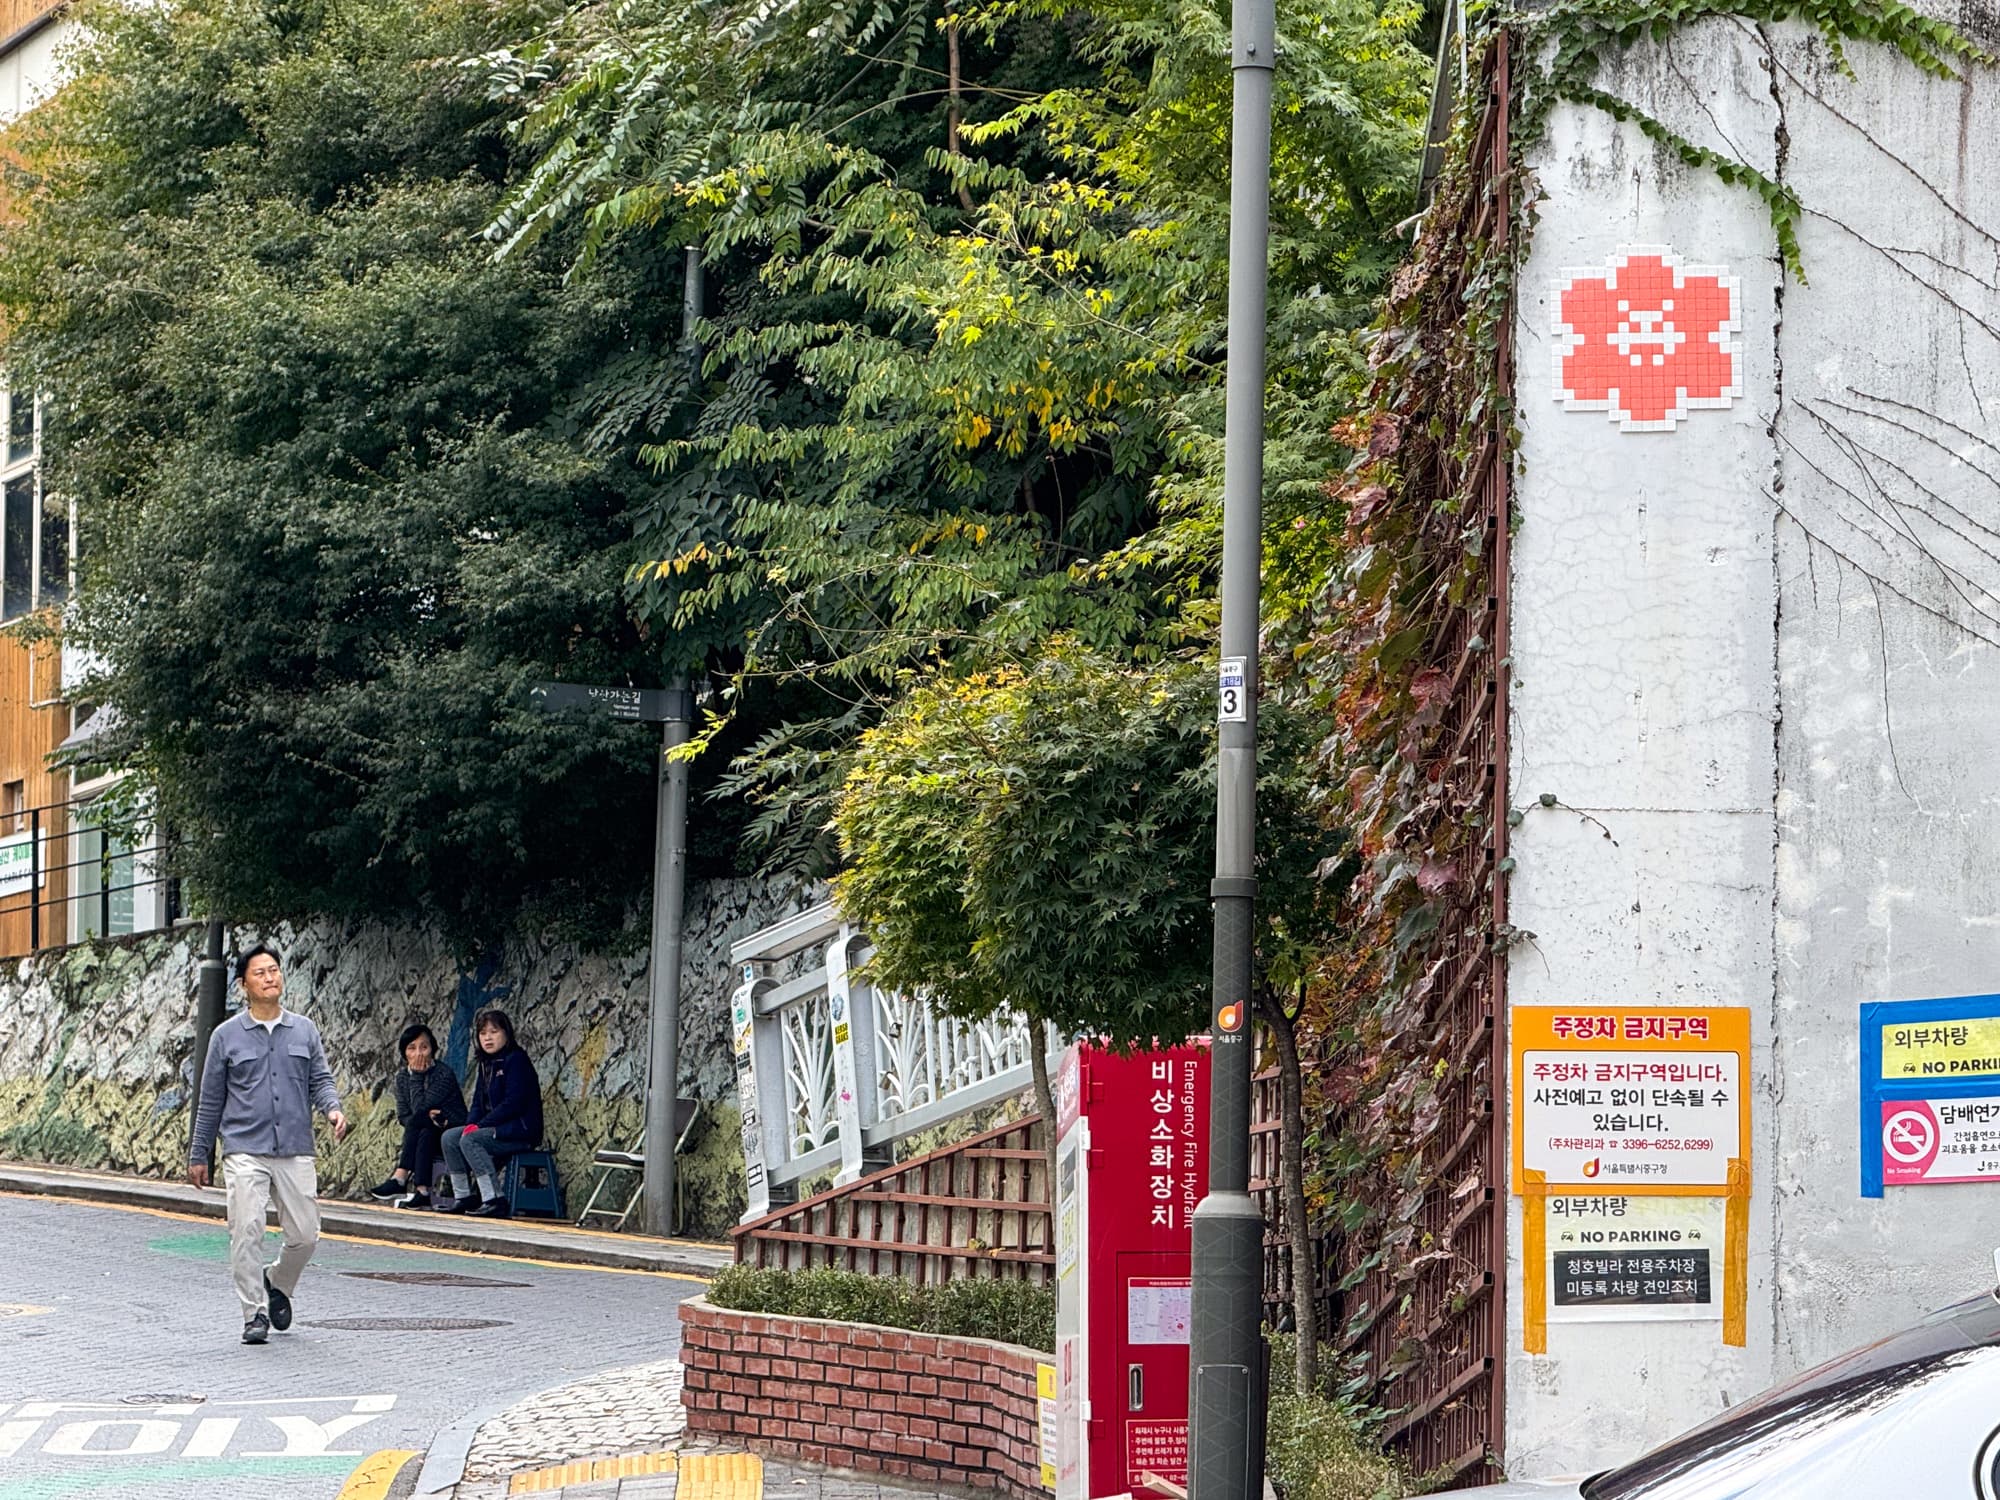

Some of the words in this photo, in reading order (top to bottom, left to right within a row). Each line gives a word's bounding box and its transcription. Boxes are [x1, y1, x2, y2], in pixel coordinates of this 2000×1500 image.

[1224, 689, 1237, 714] 3
[1553, 1016, 1617, 1039] 주정차
[1624, 1016, 1709, 1040] 금지구역
[1894, 1026, 1969, 1049] 외부차량
[1533, 1064, 1588, 1083] 주정차
[1594, 1064, 1728, 1083] 금지구역입니다.
[1922, 1061, 1946, 1074] NO
[1950, 1057, 2000, 1073] PARKI
[1180, 1060, 1198, 1138] Emergency
[1533, 1088, 1604, 1106] 사전예고
[1611, 1088, 1645, 1107] 없이
[1652, 1088, 1705, 1107] 단속될
[1711, 1088, 1729, 1107] 수
[1593, 1114, 1669, 1132] 있습니다.
[1149, 1059, 1175, 1229] 비상소화장치
[1548, 1137, 1605, 1151] (주차관리과
[1622, 1138, 1714, 1151] 3396-6252,6299)
[1183, 1142, 1198, 1168] Fire
[1602, 1163, 1668, 1175] 서울특별시중구청
[1896, 1166, 1921, 1175] Smoking
[1987, 1160, 2000, 1171] 중구
[1552, 1196, 1628, 1217] 외부차량
[1580, 1231, 1604, 1243] NO
[1608, 1230, 1682, 1243] PARKING
[1567, 1259, 1623, 1275] 청호빌라
[1626, 1258, 1696, 1274] 전용주차장
[1566, 1281, 1608, 1296] 미등록
[1611, 1280, 1640, 1296] 차량
[1643, 1279, 1698, 1295] 견인조치
